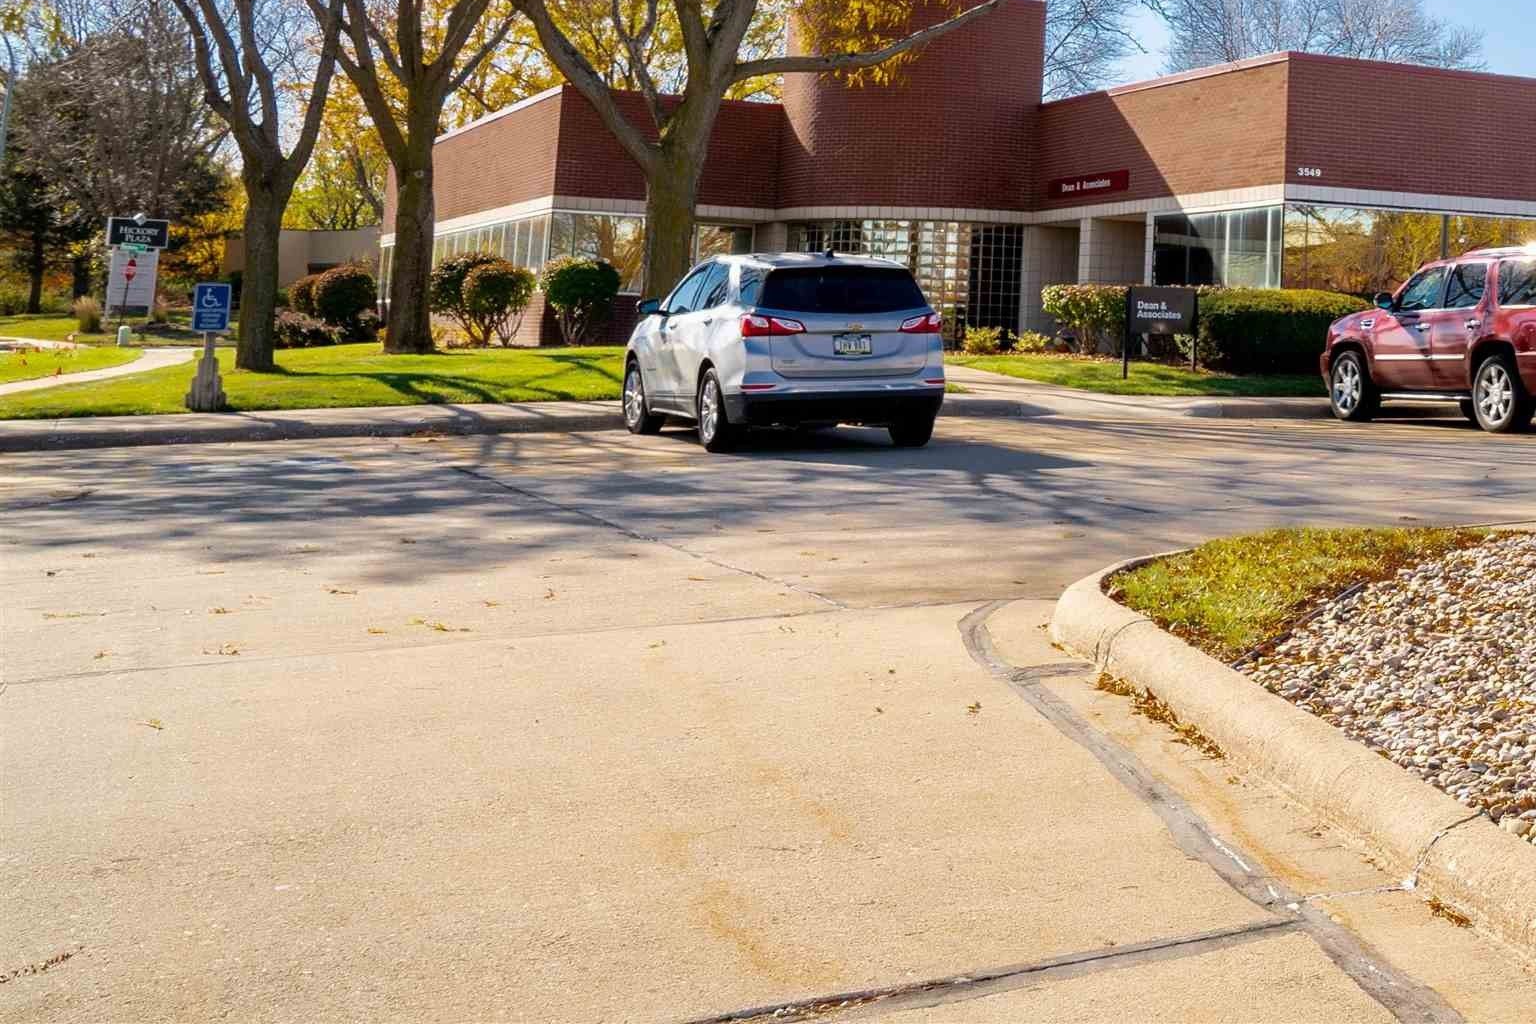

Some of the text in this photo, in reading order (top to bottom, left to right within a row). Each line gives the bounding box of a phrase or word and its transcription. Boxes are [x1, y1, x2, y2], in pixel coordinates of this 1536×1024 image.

[1297, 167, 1321, 176] 3549
[1137, 300, 1167, 310] Dean &
[1136, 310, 1181, 319] Associates
